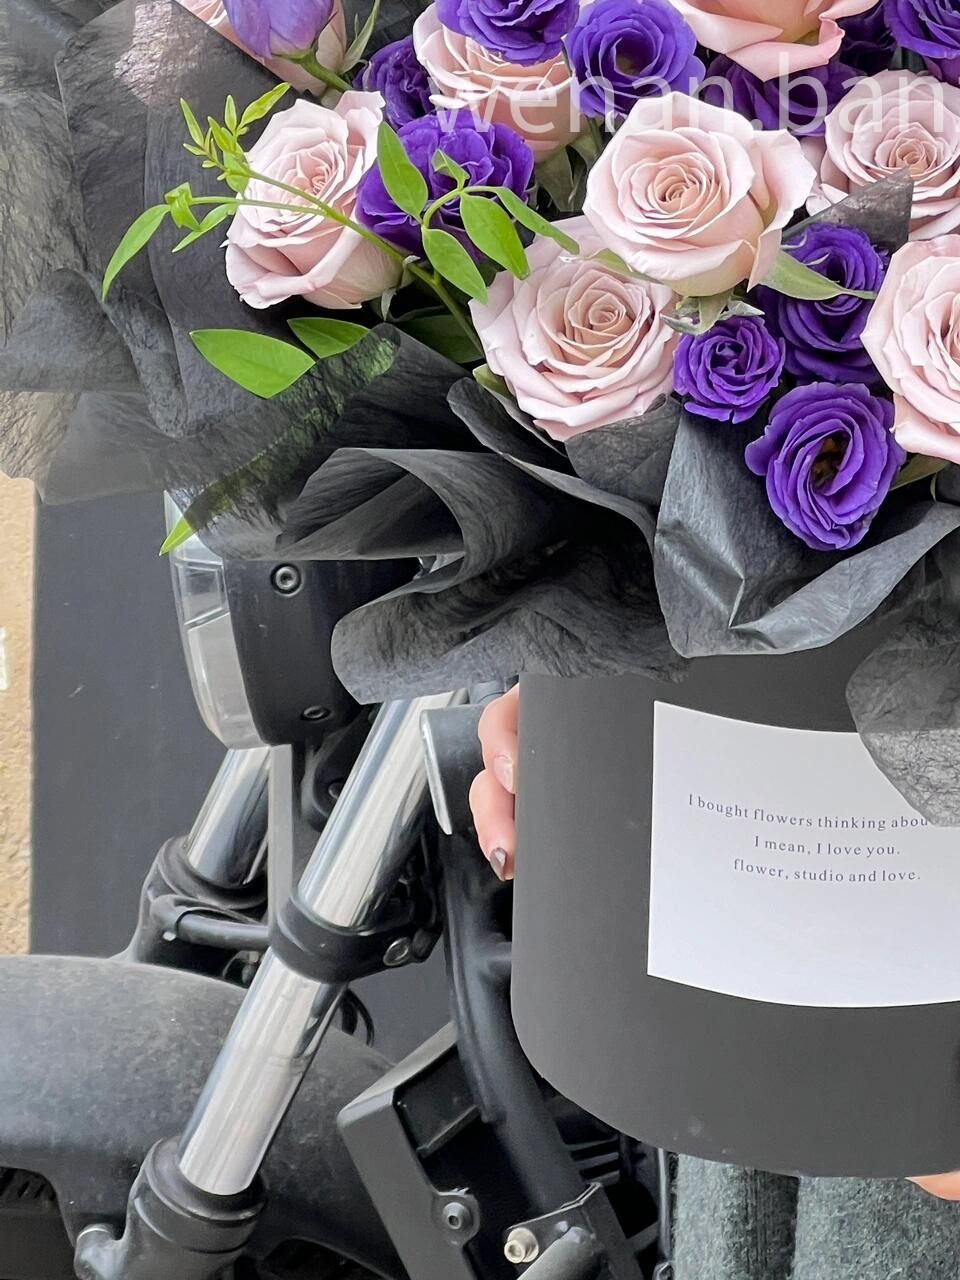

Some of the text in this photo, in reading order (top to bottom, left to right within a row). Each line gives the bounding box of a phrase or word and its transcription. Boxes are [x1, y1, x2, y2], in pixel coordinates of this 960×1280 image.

[698, 796, 749, 818] bought
[753, 808, 813, 828] flowers
[818, 816, 887, 831] thinking
[891, 816, 929, 828] abou
[765, 839, 811, 855] mean,
[827, 843, 862, 856] love
[867, 846, 901, 858] you.
[734, 859, 921, 882] flower, studio and love.
